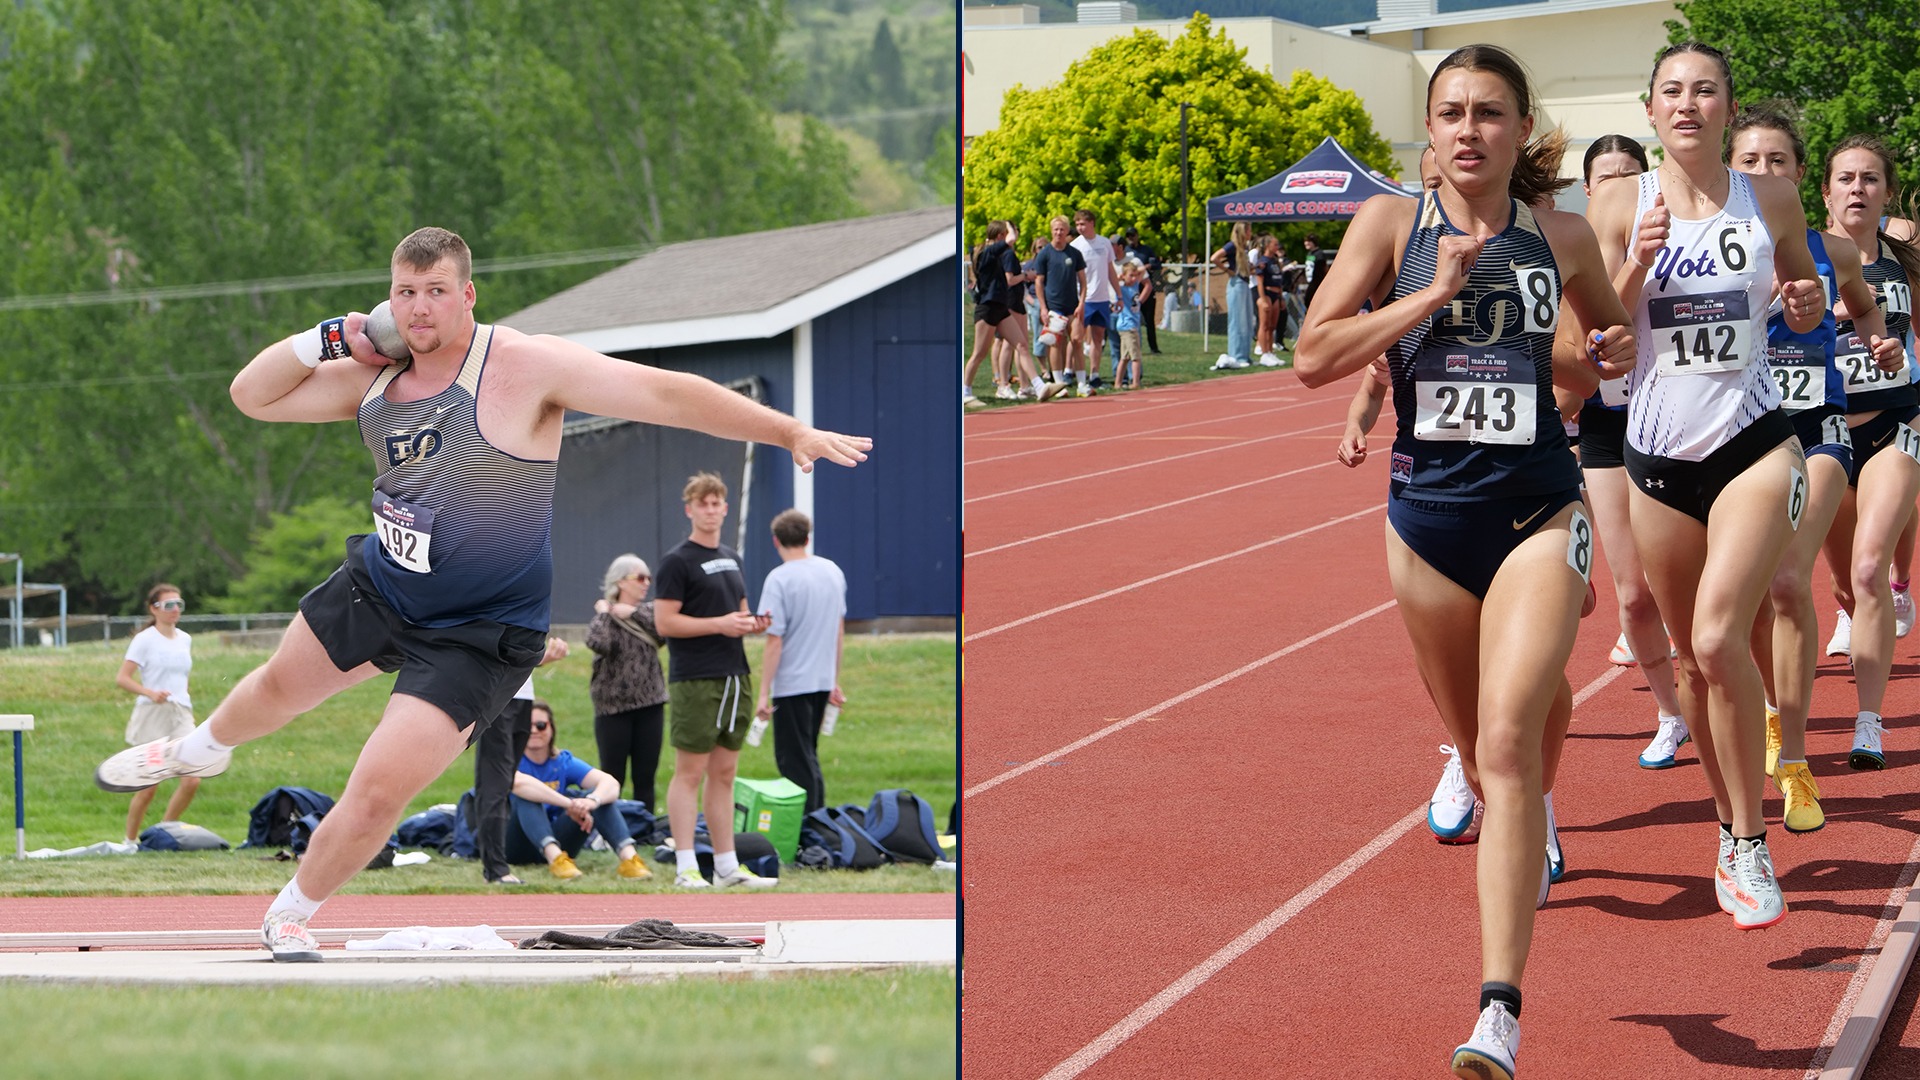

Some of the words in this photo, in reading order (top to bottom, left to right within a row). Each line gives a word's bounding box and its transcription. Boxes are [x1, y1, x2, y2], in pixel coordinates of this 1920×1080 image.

[1225, 202, 1294, 215] CASCADE
[1297, 202, 1363, 215] CONFER
[1718, 227, 1747, 272] 6
[1527, 270, 1555, 329] 8
[1890, 284, 1909, 312] 11
[1671, 325, 1739, 367] 142
[1435, 386, 1516, 433] 243
[1791, 476, 1804, 521] 6
[383, 522, 417, 564] 192
[1574, 518, 1590, 576] 8
